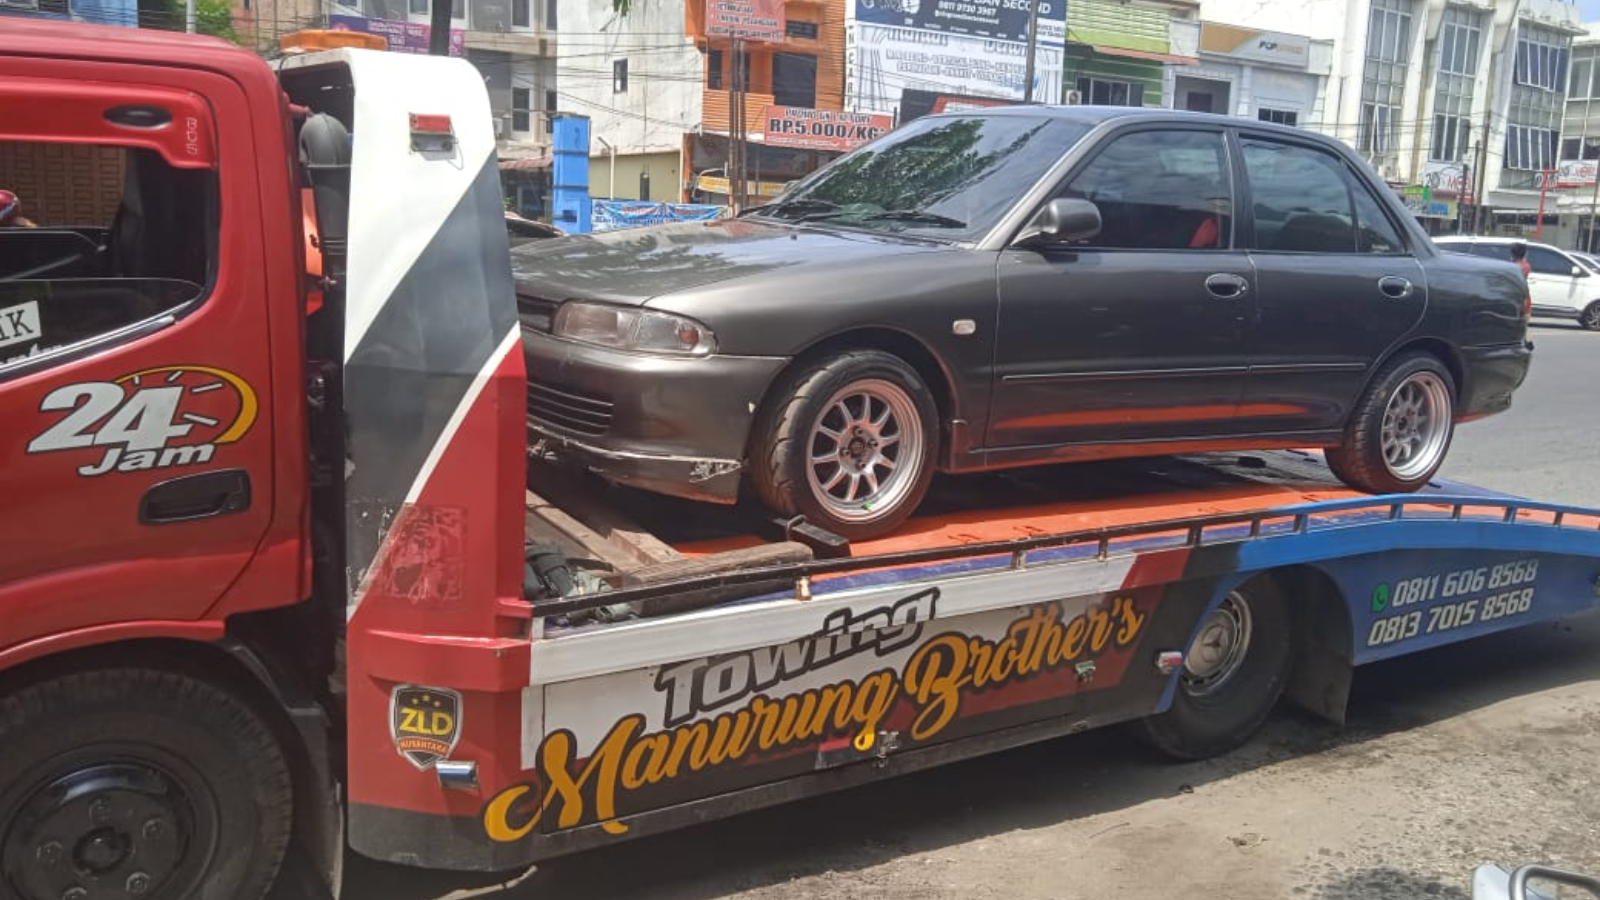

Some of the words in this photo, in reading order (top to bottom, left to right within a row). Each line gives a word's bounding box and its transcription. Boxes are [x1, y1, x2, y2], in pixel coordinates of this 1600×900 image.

[27, 381, 194, 453] 24
[77, 443, 215, 477] Jam
[1391, 574, 1441, 608] 0811
[1442, 567, 1488, 598] 606
[1488, 559, 1539, 590] 8568
[1367, 611, 1422, 647] 0813
[1426, 600, 1480, 634] 7015
[1480, 588, 1535, 621] 8568
[655, 587, 940, 728] Towing
[904, 597, 1145, 741] Brother's
[400, 707, 454, 736] ZLD
[401, 739, 448, 755] NUSANTARA
[484, 671, 900, 843] Manurung
